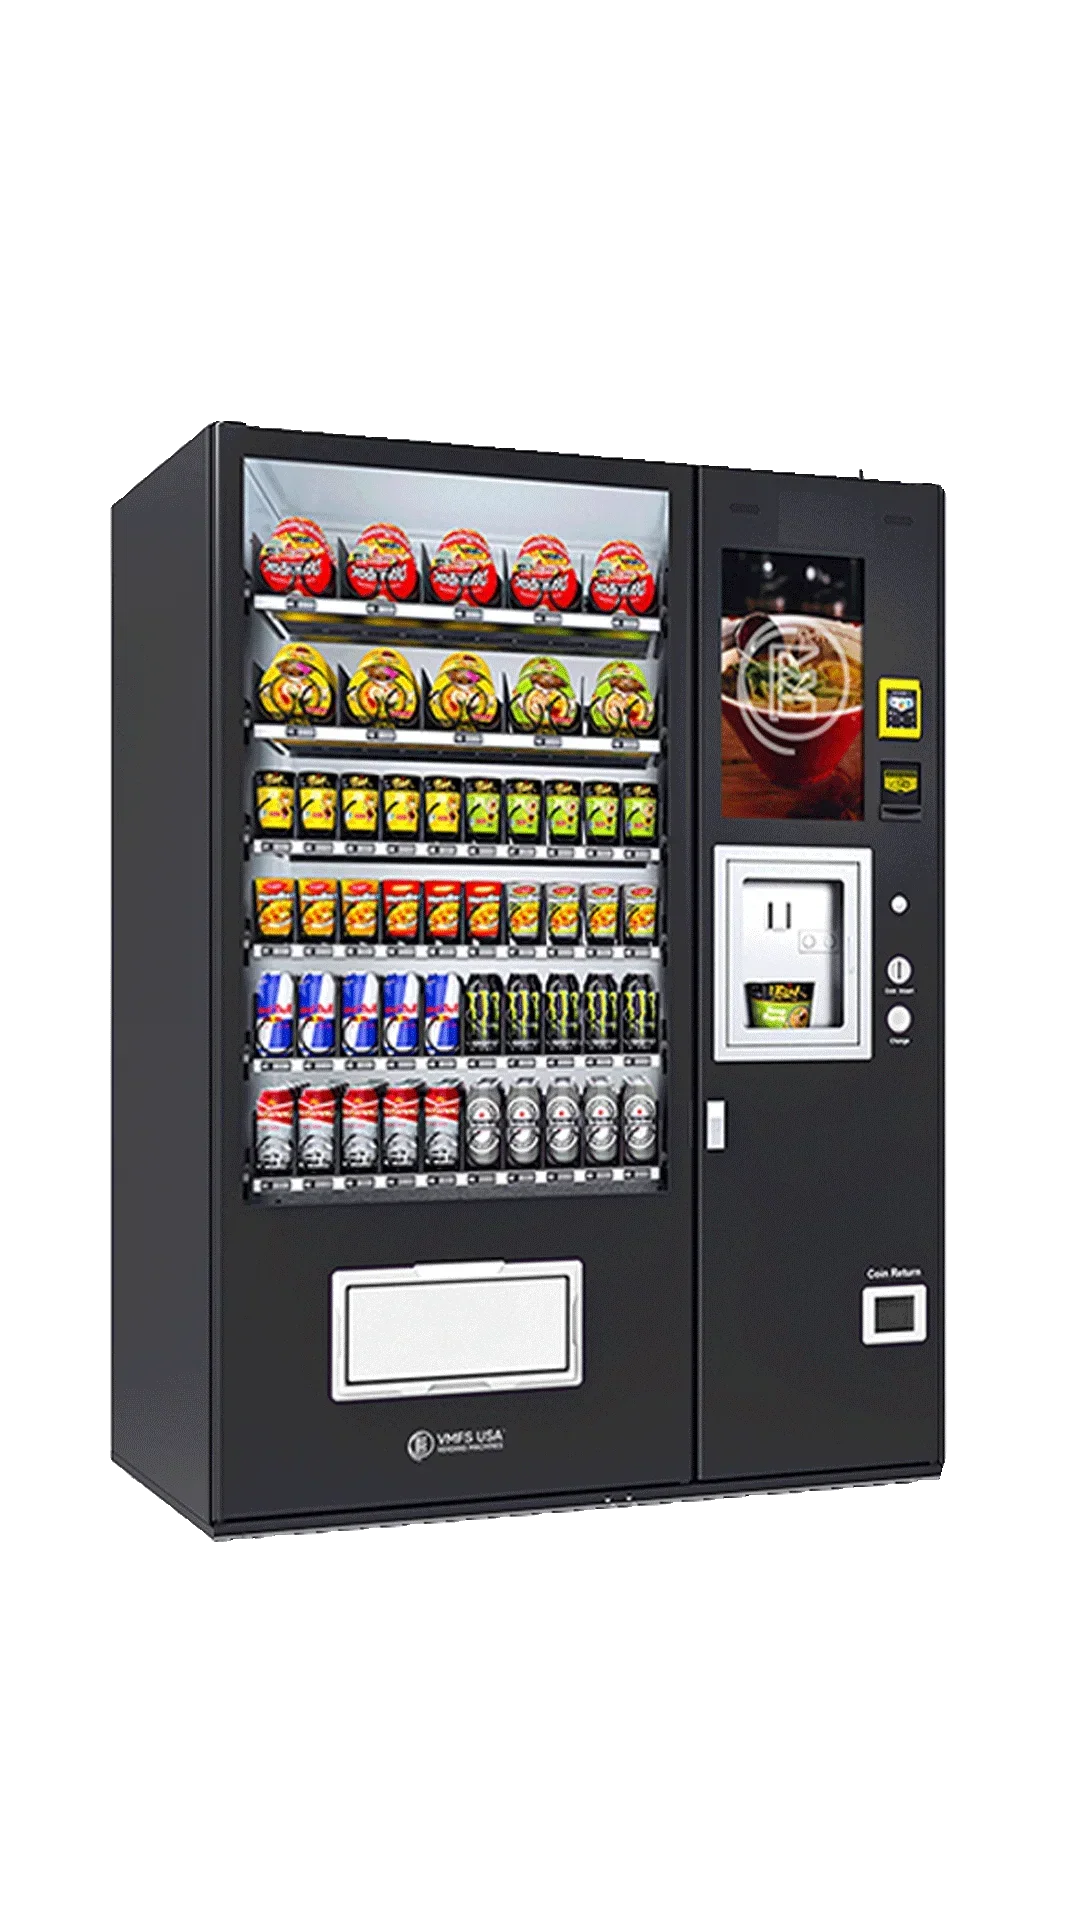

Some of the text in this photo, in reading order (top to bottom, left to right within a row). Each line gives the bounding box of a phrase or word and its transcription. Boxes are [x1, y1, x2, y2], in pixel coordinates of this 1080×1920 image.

[867, 1267, 921, 1279] Coin Return
[436, 1429, 503, 1445] VMFS USA
